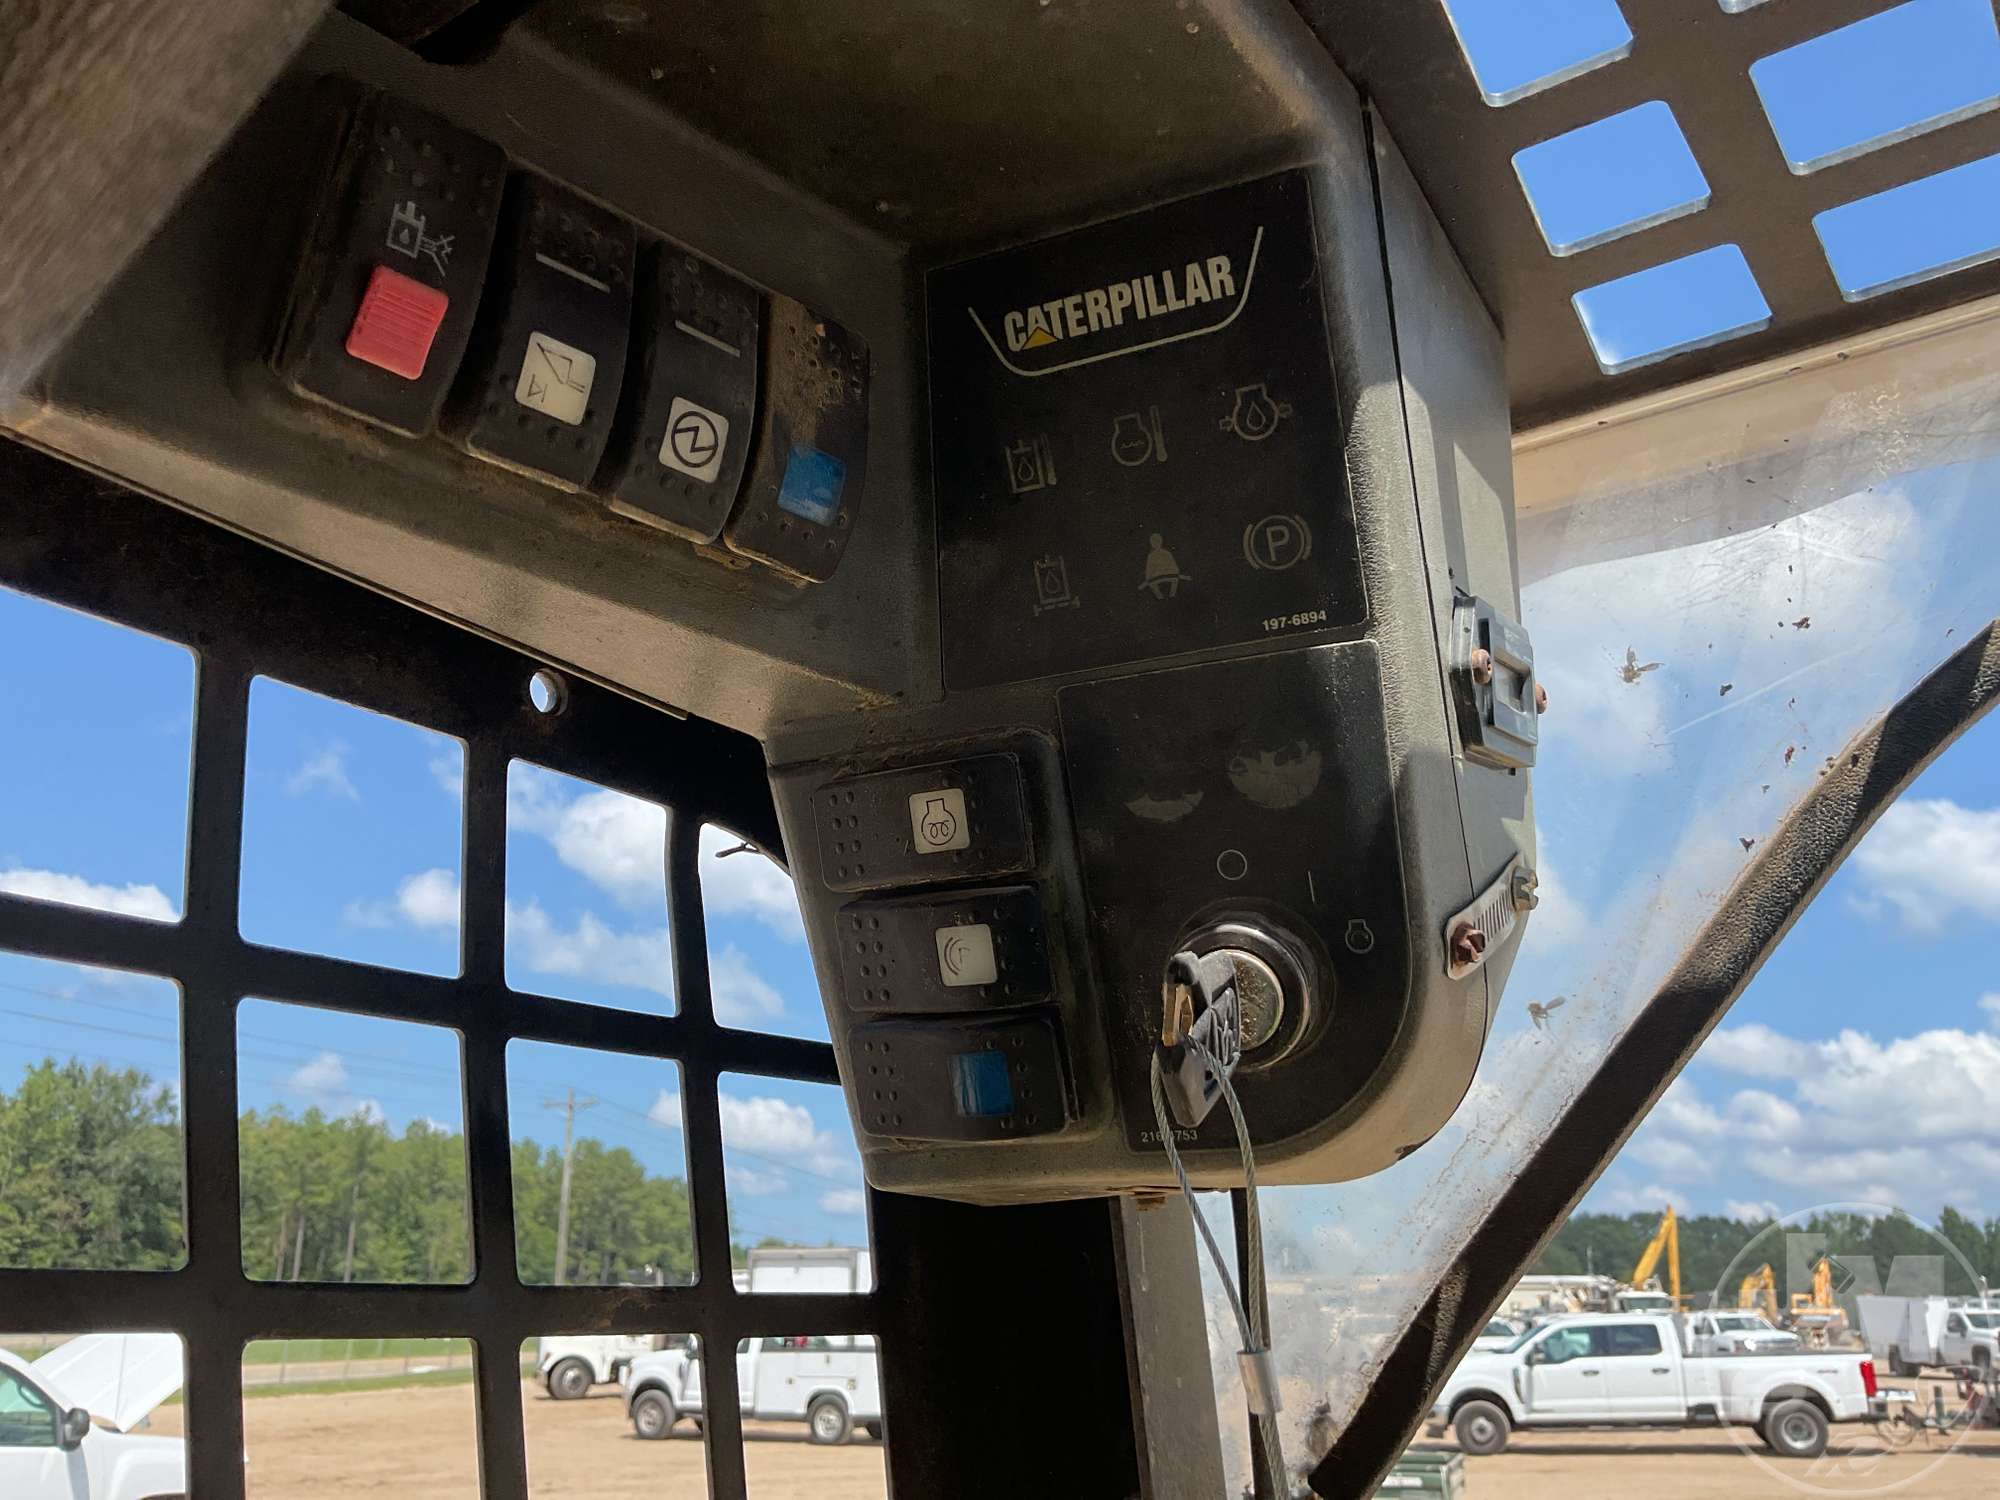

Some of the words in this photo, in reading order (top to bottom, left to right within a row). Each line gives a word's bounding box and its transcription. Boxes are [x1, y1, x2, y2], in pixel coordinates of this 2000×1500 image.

[1004, 255, 1235, 351] CATERPILLAR
[1266, 525, 1290, 561] P
[1262, 610, 1327, 631] 197-6894
[1140, 1129, 1198, 1143] 216753
